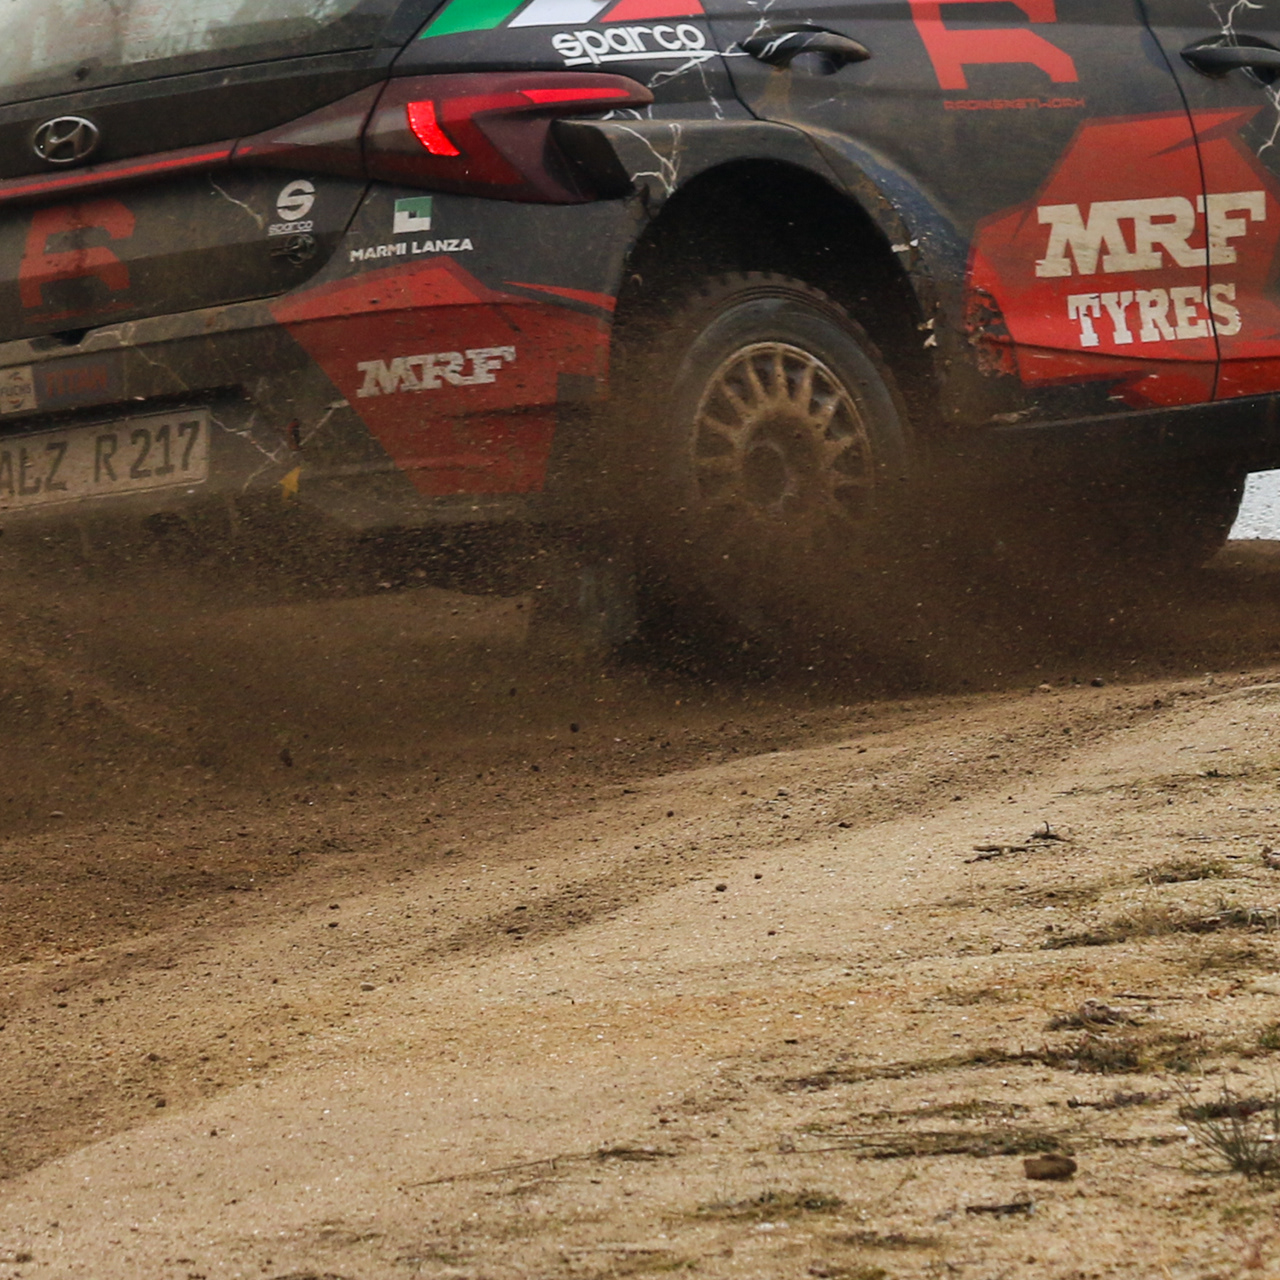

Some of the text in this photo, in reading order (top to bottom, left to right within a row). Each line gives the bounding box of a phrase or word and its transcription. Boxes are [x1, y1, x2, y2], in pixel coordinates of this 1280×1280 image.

[552, 22, 706, 65] sparco
[349, 238, 474, 263] MARMI LANZA
[1034, 190, 1266, 278] MRF
[1068, 283, 1242, 348] TYRES
[356, 345, 516, 398] MRF
[93, 433, 118, 483] R
[129, 421, 200, 480] 217
